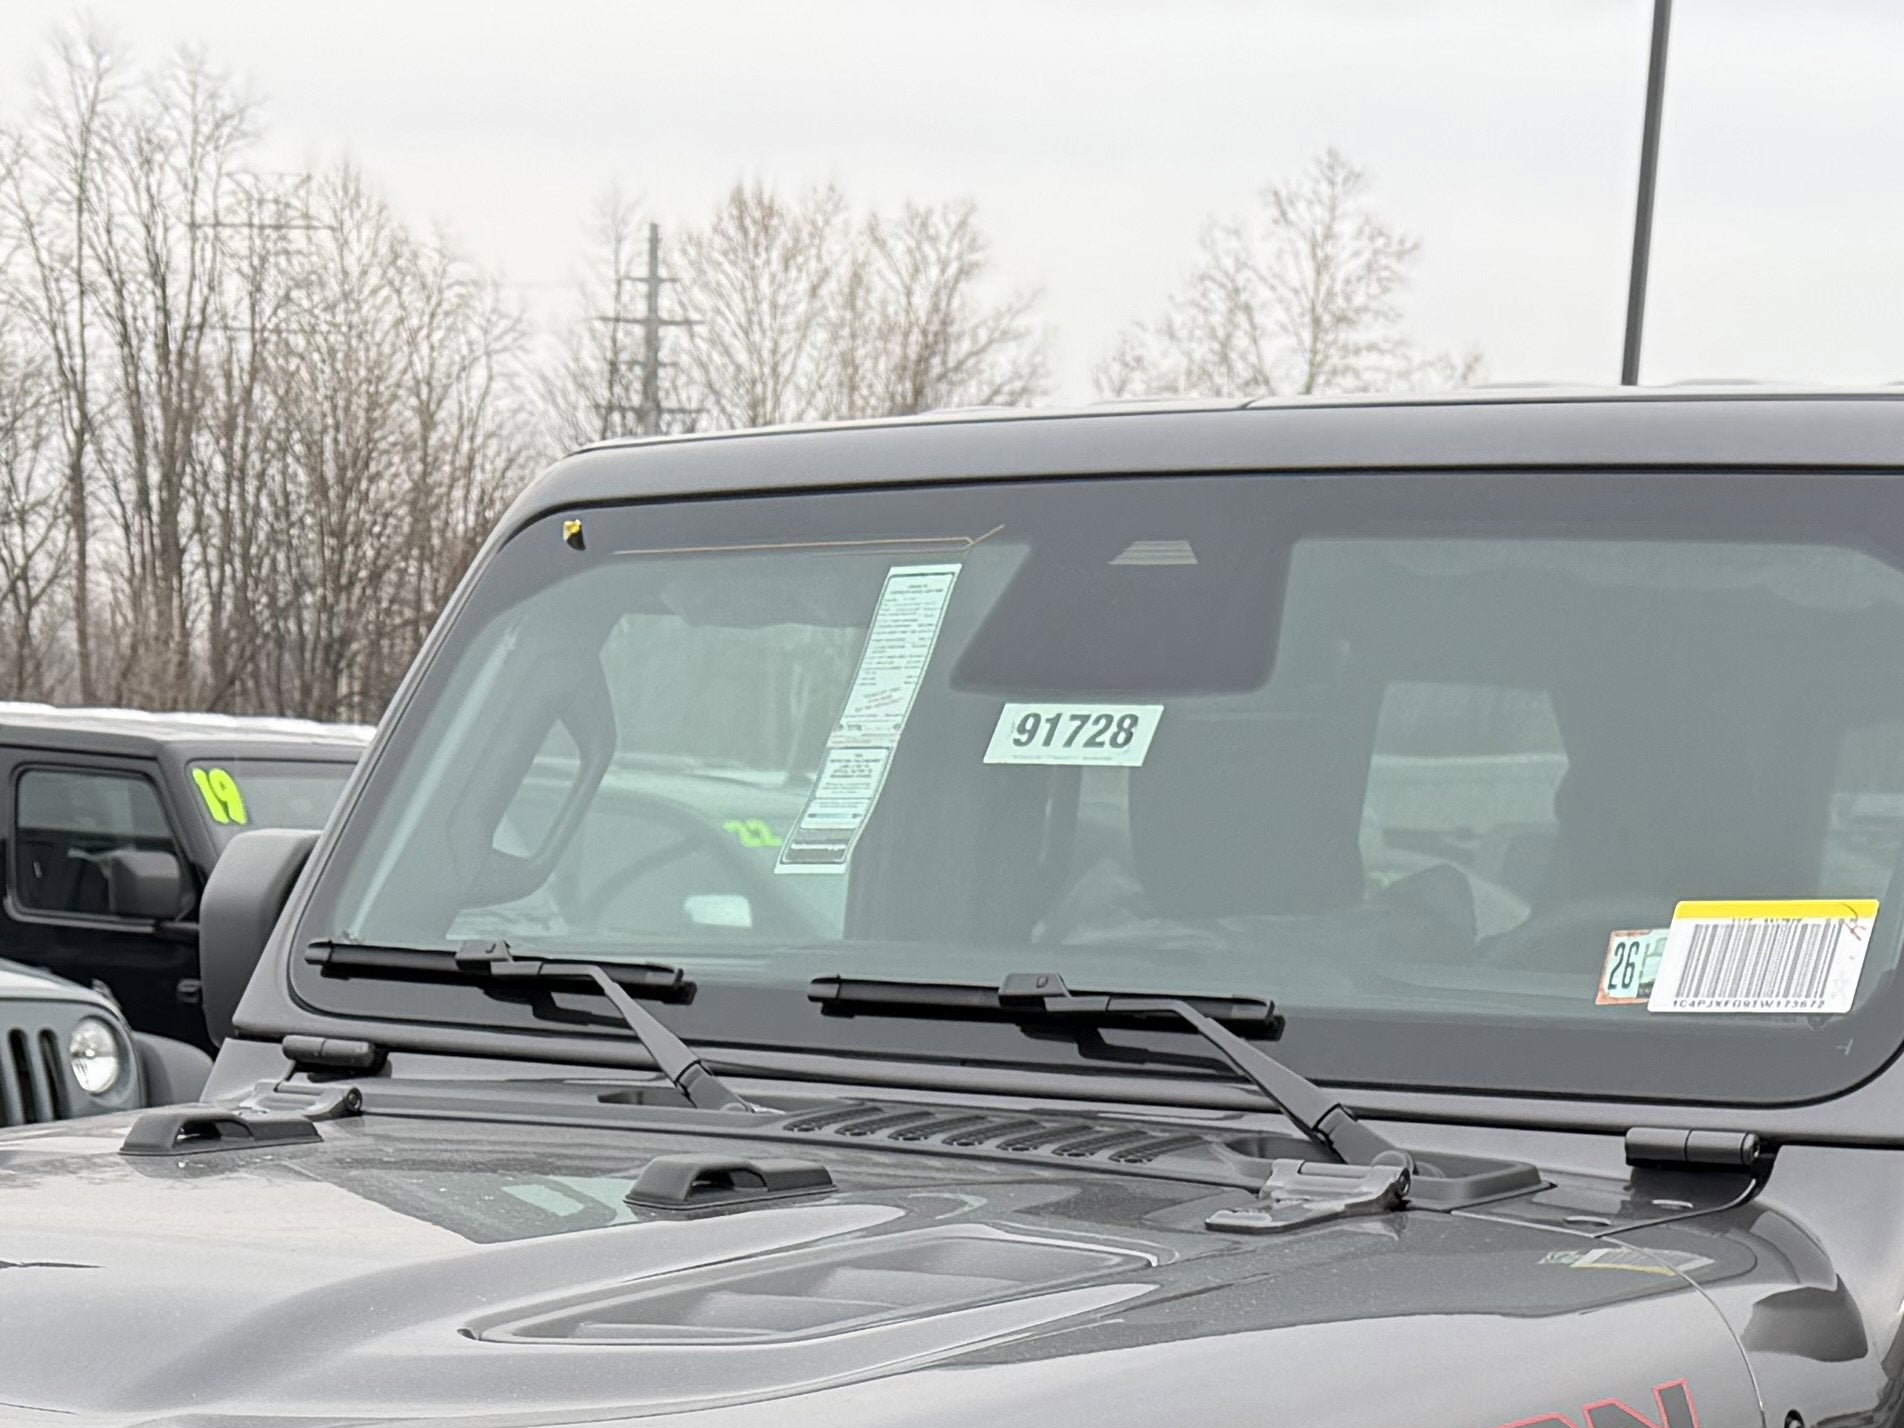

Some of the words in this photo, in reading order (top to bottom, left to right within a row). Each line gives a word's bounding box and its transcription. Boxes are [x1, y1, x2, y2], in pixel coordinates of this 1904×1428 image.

[1012, 712, 1140, 749] 91728
[192, 767, 247, 825] 19
[1607, 940, 1640, 991] 26
